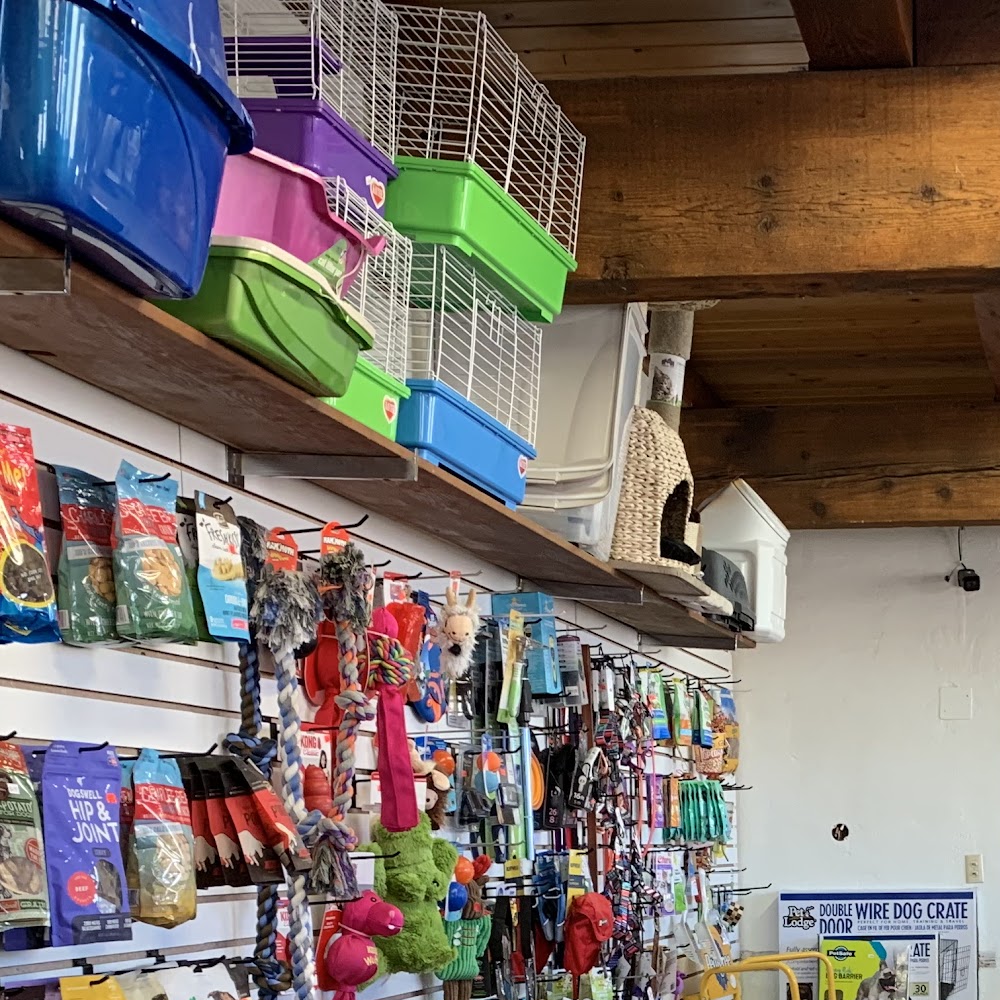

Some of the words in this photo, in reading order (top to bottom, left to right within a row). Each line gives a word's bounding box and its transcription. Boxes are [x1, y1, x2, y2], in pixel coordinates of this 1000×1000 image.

[300, 735, 317, 749] KONG
[67, 787, 103, 800] DOGSWELL
[69, 800, 95, 821] HIP
[97, 800, 111, 821] &
[72, 822, 120, 844] JOINT
[75, 885, 89, 893] BEEF
[819, 903, 853, 917] DOUBLE
[855, 902, 890, 920] WIRE
[893, 901, 924, 920] DOG
[926, 901, 968, 920] CRATE
[782, 915, 816, 930] Lodge
[819, 917, 853, 934] DOOR
[909, 943, 931, 957] ATE
[914, 984, 927, 993] 30
